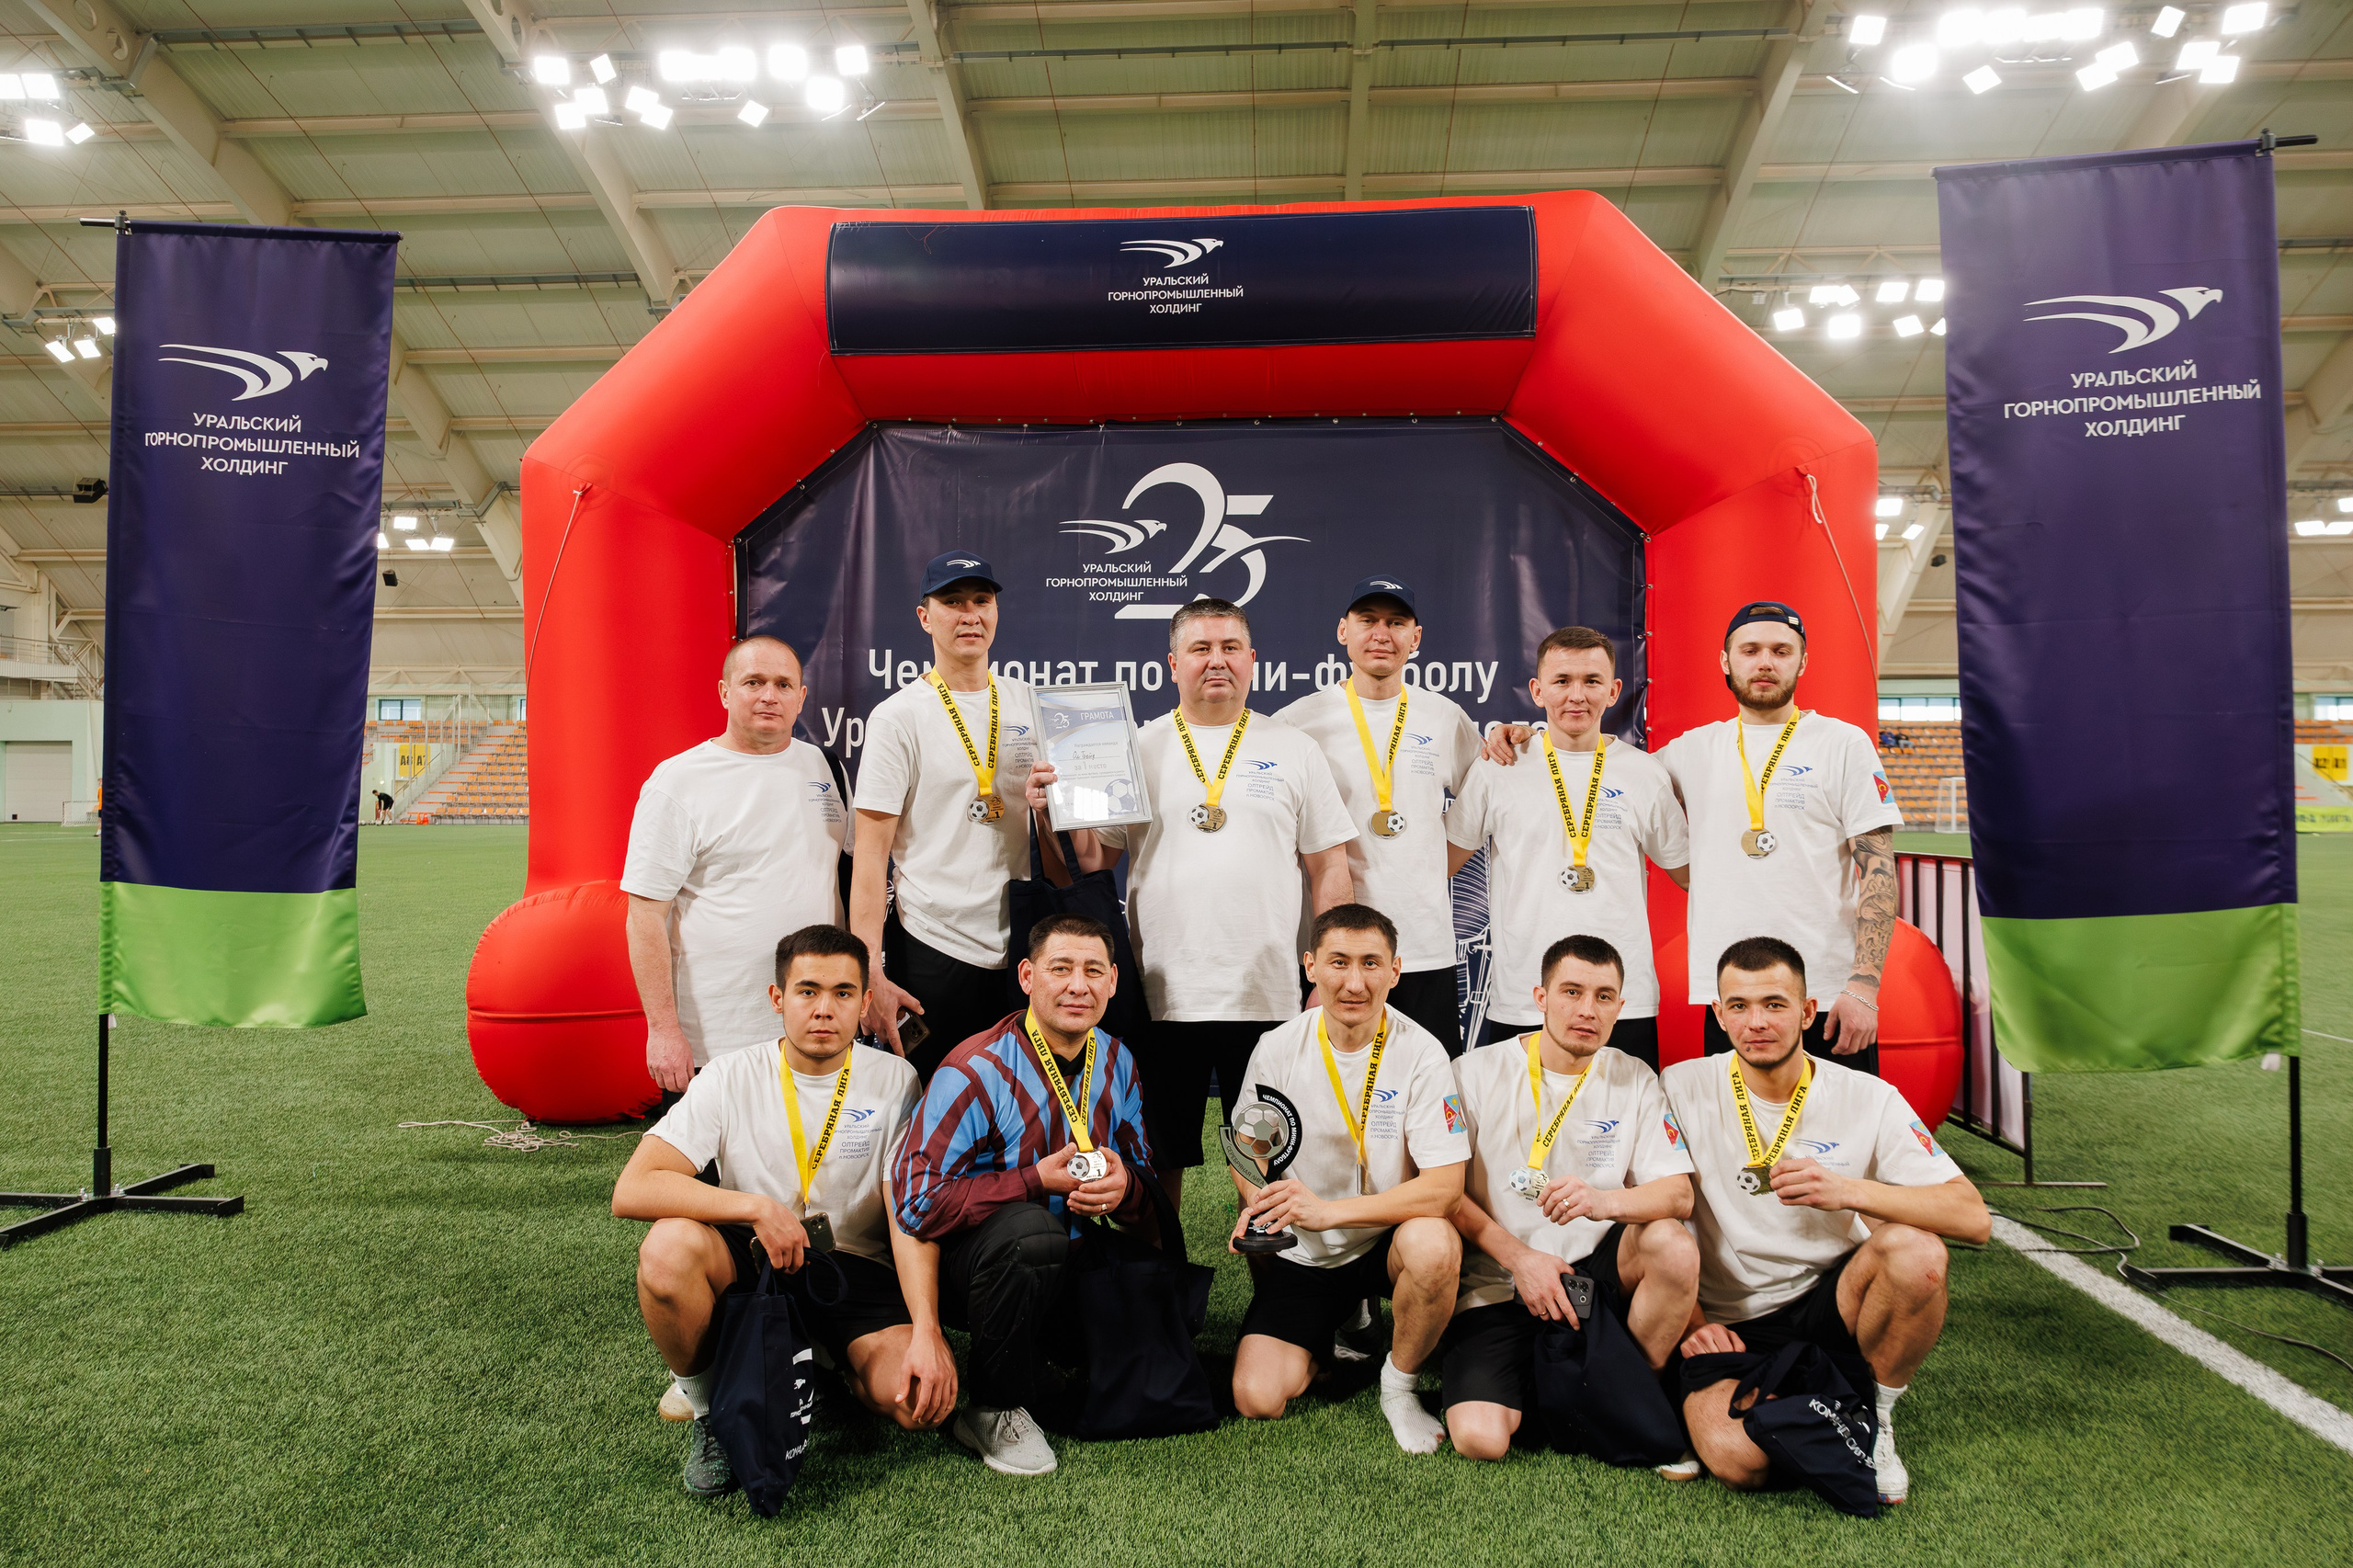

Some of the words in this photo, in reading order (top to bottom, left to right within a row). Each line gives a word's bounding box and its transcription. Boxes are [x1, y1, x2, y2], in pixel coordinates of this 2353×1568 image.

[1142, 273, 1209, 287] УРАЛЬСКИЙ
[1108, 286, 1244, 301] ГОРНОПРОМЫШЛЕННЫЙ
[1150, 303, 1202, 314] ХОЛДИНГ
[2071, 359, 2197, 388] УРАЛЬСКИЙ
[2004, 379, 2261, 418] ГОРНОПРОМЫШЛЕННЫЙ
[192, 412, 302, 433] УРАЛЬСКИЙ
[2085, 415, 2187, 437] ХОЛДИНГ
[144, 431, 360, 458] ГОРНОПРОМЫШЛЕННЫЙ
[200, 457, 288, 475] ХОЛДИНГ
[1083, 561, 1152, 574] УРАЛЬСКИЙ
[1046, 574, 1188, 588] ГОРНОПРОМЫШЛЕННЫЙ
[1088, 591, 1144, 603] ХОЛДИНГ
[1115, 661, 1164, 690] по
[937, 683, 952, 705] ЛИГА
[1080, 710, 1115, 722] ГРАМОТА
[1175, 711, 1187, 733] ЛИГА
[1397, 702, 1407, 723] ЛИГА
[949, 707, 980, 767] СЕРЕБРЯНАЯ
[988, 709, 998, 768] СЕРЕБРЯНАЯ
[1781, 722, 1798, 742] ЛИГА
[1182, 733, 1206, 783] СЕРЕБРЯНАЯ
[1218, 729, 1243, 779] СЕРЕБРЯНАЯ
[1547, 751, 1559, 776] ЛИГА
[1247, 783, 1274, 791] ОЛТРЕЙД
[1581, 777, 1599, 838] СЕРЕБРЯНАЯ
[1594, 752, 1604, 776] ЛИГА
[995, 811, 1001, 819] 1
[1554, 778, 1576, 838] СЕРЕБРЯНАЯ
[1211, 822, 1218, 830] 1
[1585, 881, 1590, 890] 1
[1031, 1028, 1048, 1057] ЛИГА
[1372, 1030, 1384, 1059] ЛИГА
[1044, 1058, 1078, 1123] СЕРЕБРЯНАЯ
[1081, 1062, 1091, 1126] СЕРЕБРЯНАЯ
[1087, 1037, 1096, 1062] ЛИГА
[1732, 1071, 1745, 1100] ЛИГА
[812, 1098, 842, 1170] СЕРЕБРЯНАЯ
[837, 1068, 850, 1097] ЛИГА
[1262, 1094, 1293, 1118] ЧЕМПИОНАТ
[1289, 1117, 1296, 1127] ПО
[1542, 1094, 1574, 1147] СЕРЕБРЯНАЯ
[1740, 1104, 1760, 1160] ЕРЕБРЯНАЯ
[1762, 1115, 1794, 1166] ЕРЕБРЯНАЯ
[1790, 1085, 1808, 1114] ЛИГА
[1097, 1168, 1102, 1177] 1
[1227, 1145, 1252, 1175] СЕРЕБРЯНАЯ
[1250, 1173, 1266, 1186] ЛИГА
[1535, 1190, 1540, 1199] 1
